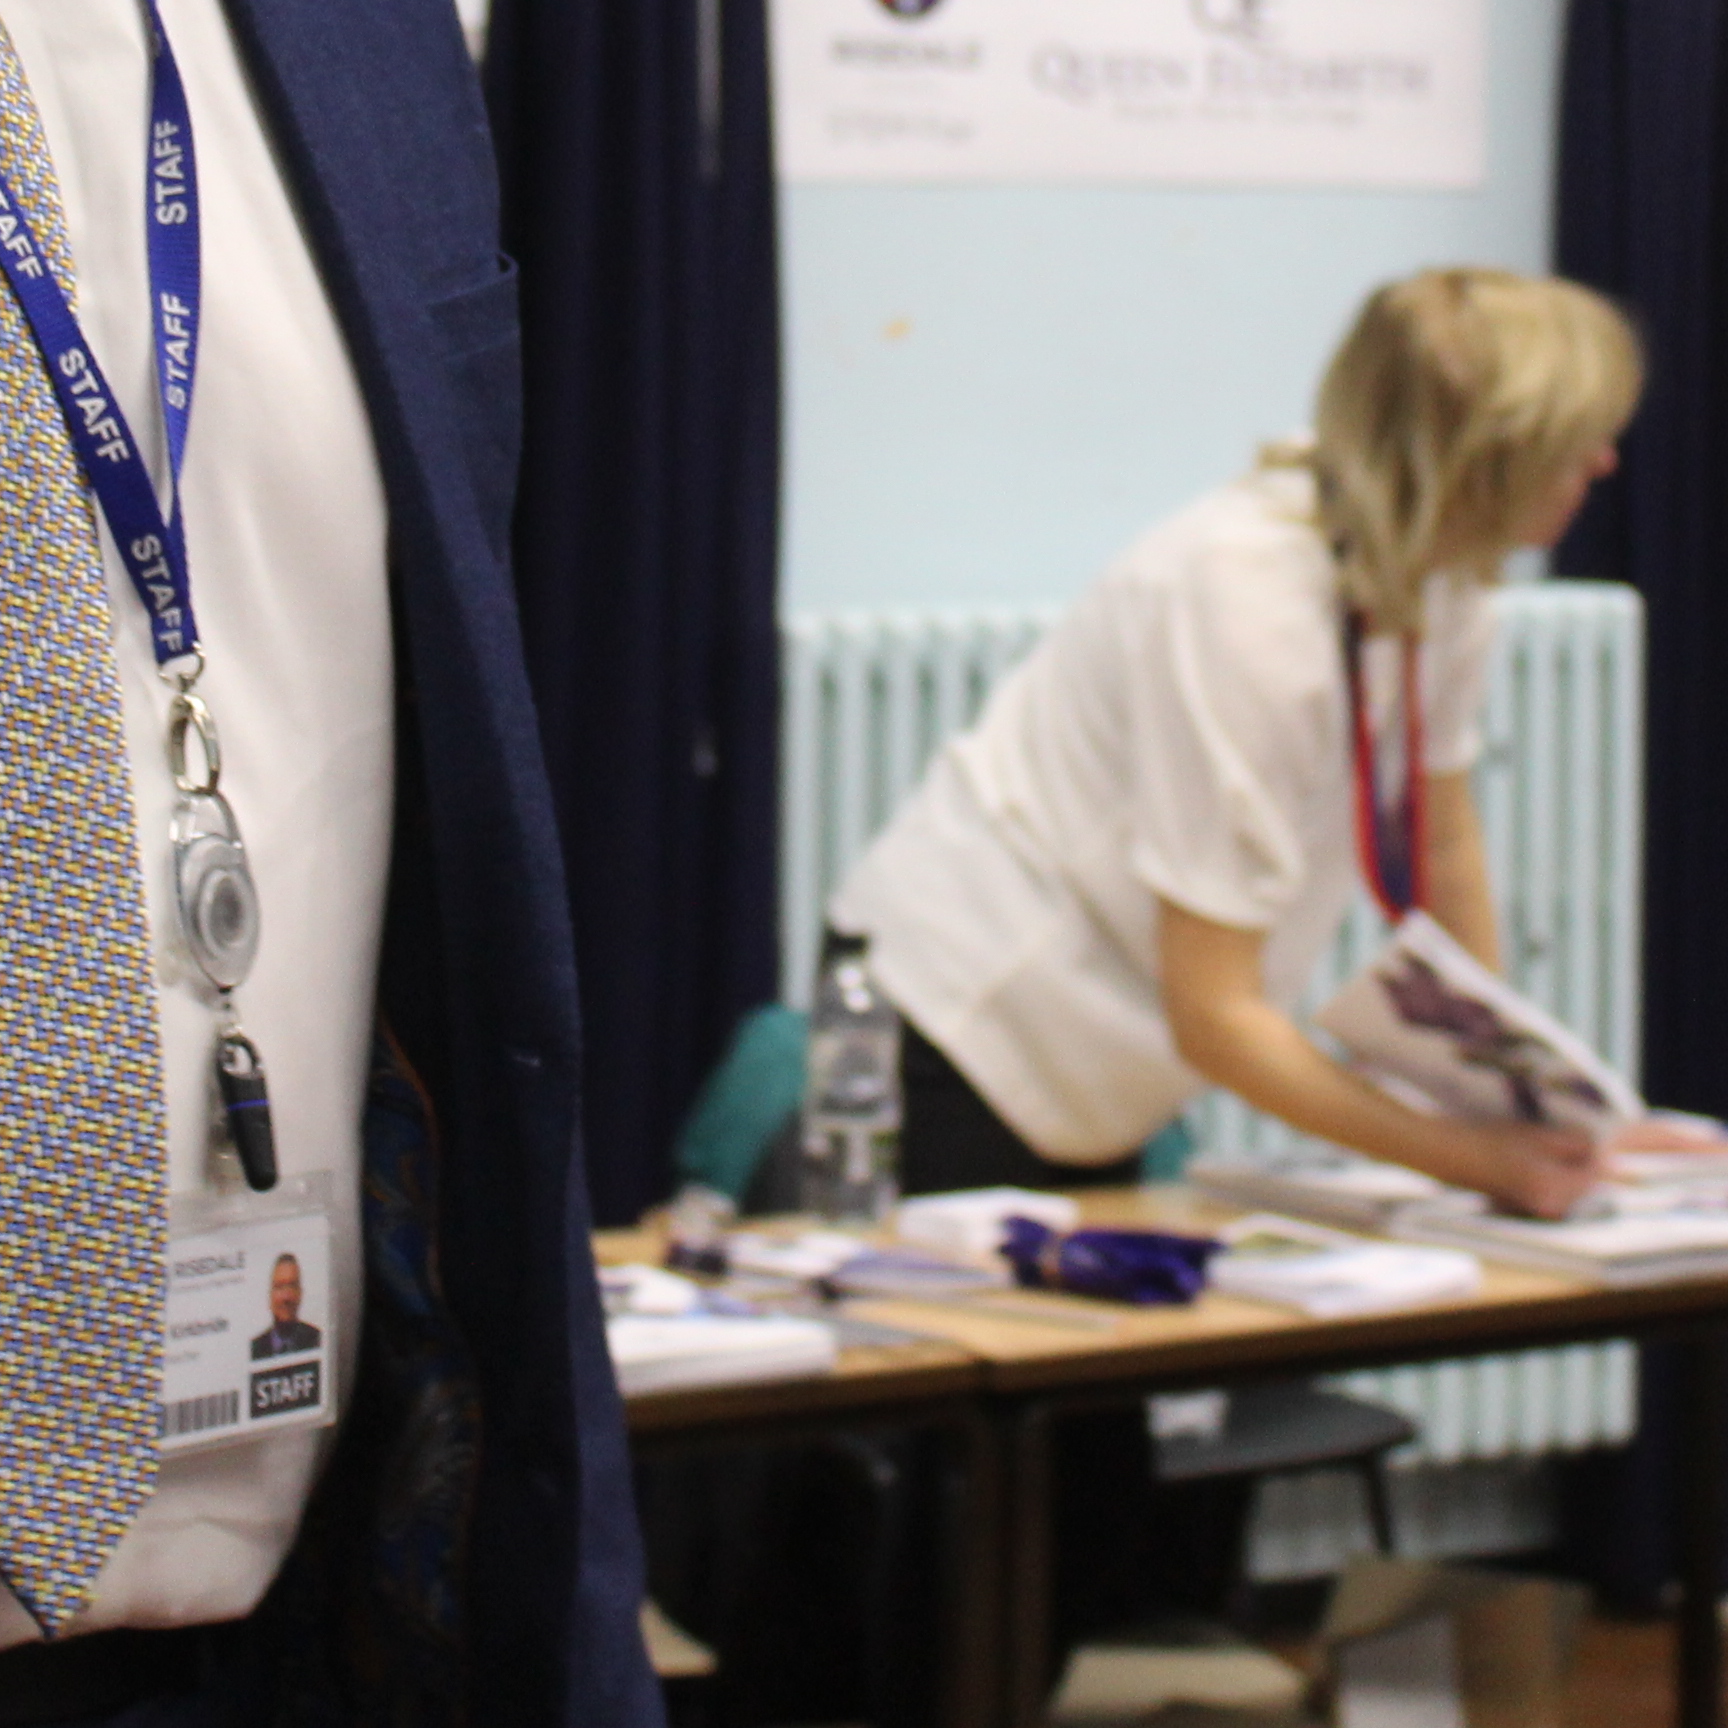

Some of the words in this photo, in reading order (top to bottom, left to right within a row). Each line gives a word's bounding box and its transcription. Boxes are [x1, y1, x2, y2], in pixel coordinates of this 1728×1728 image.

[155, 120, 186, 224] STAFF
[59, 347, 130, 464] STAFF
[160, 294, 190, 409] STAFF
[131, 534, 183, 652] STAFF
[256, 1372, 314, 1409] STAFF
